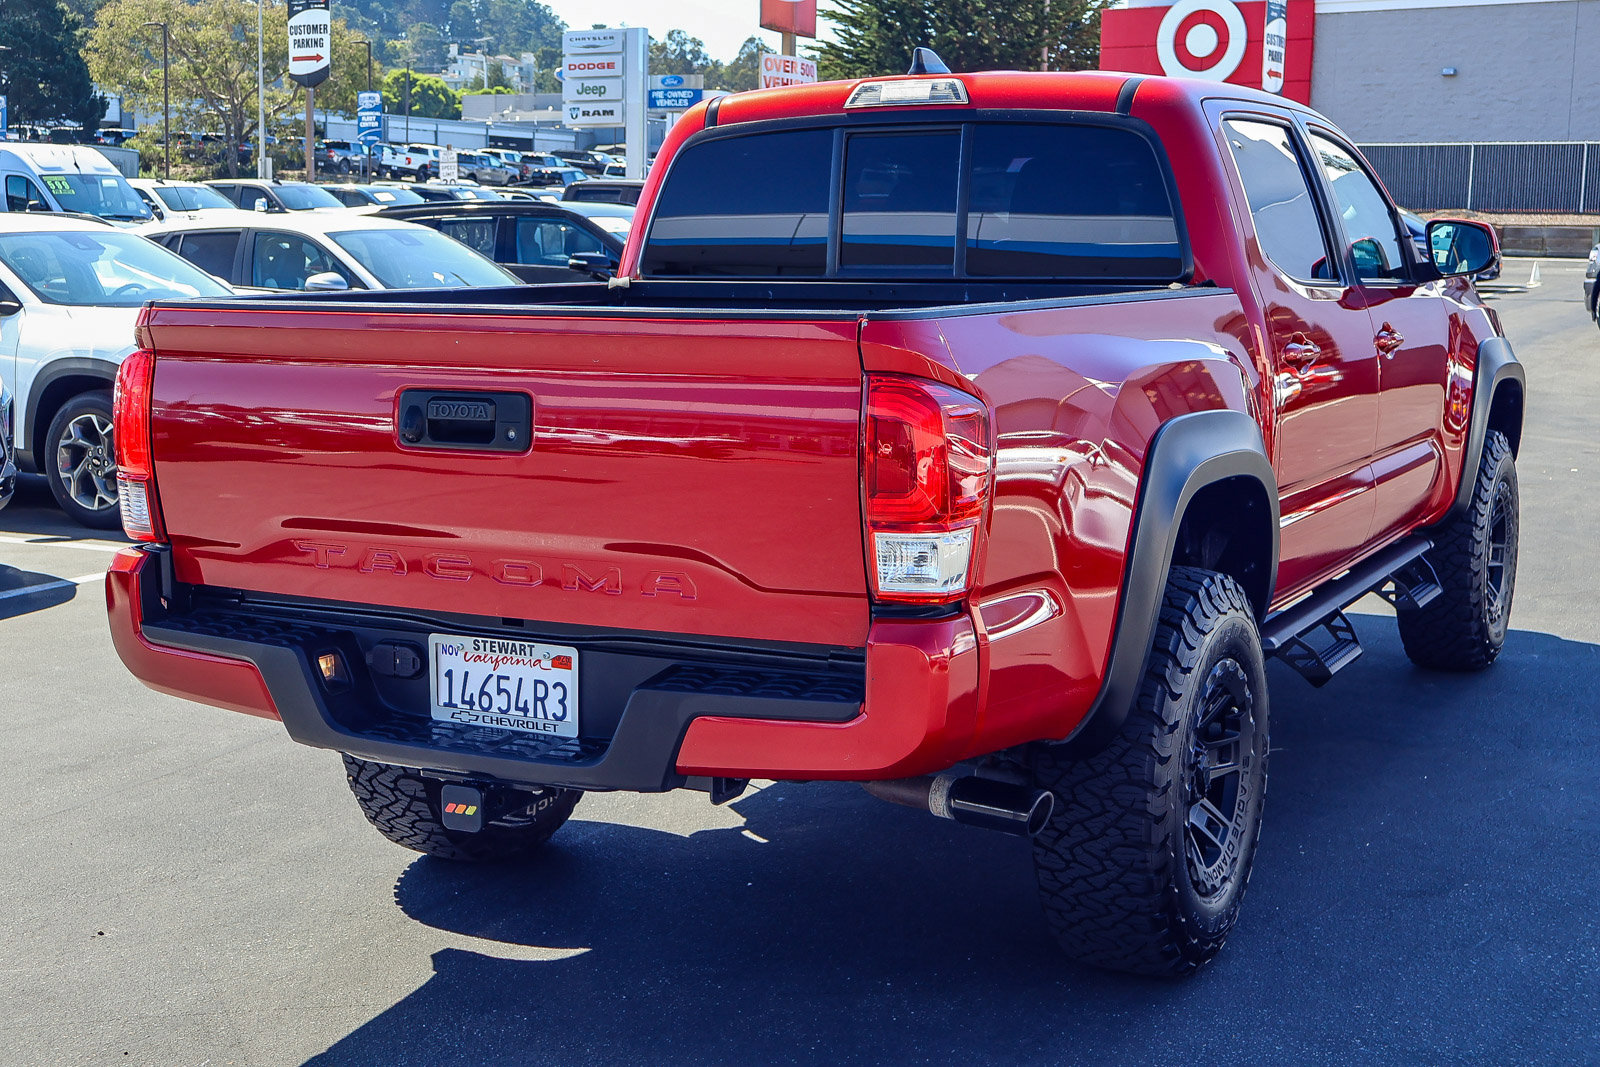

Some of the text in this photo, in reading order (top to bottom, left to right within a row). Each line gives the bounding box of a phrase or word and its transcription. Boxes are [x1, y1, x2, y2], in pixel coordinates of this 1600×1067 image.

[289, 23, 328, 36] CUSTOMER
[293, 37, 324, 49] PARKING
[568, 61, 616, 71] DODGE
[764, 57, 815, 78] OVER 500
[576, 82, 607, 97] Jeep
[652, 90, 693, 99] PRE-OWNED
[656, 98, 689, 107] VEHICLES
[581, 109, 615, 117] RAM
[430, 404, 488, 418] TOYOTA
[294, 540, 698, 600] TACOMA
[441, 643, 459, 657] NOV
[472, 638, 536, 658] STEWART
[463, 651, 552, 671] California
[442, 668, 568, 722] 14654R3
[482, 714, 560, 733] CHEVROLET
[1231, 755, 1251, 840] BLAQUE
[1203, 839, 1236, 886] DIAMOND
